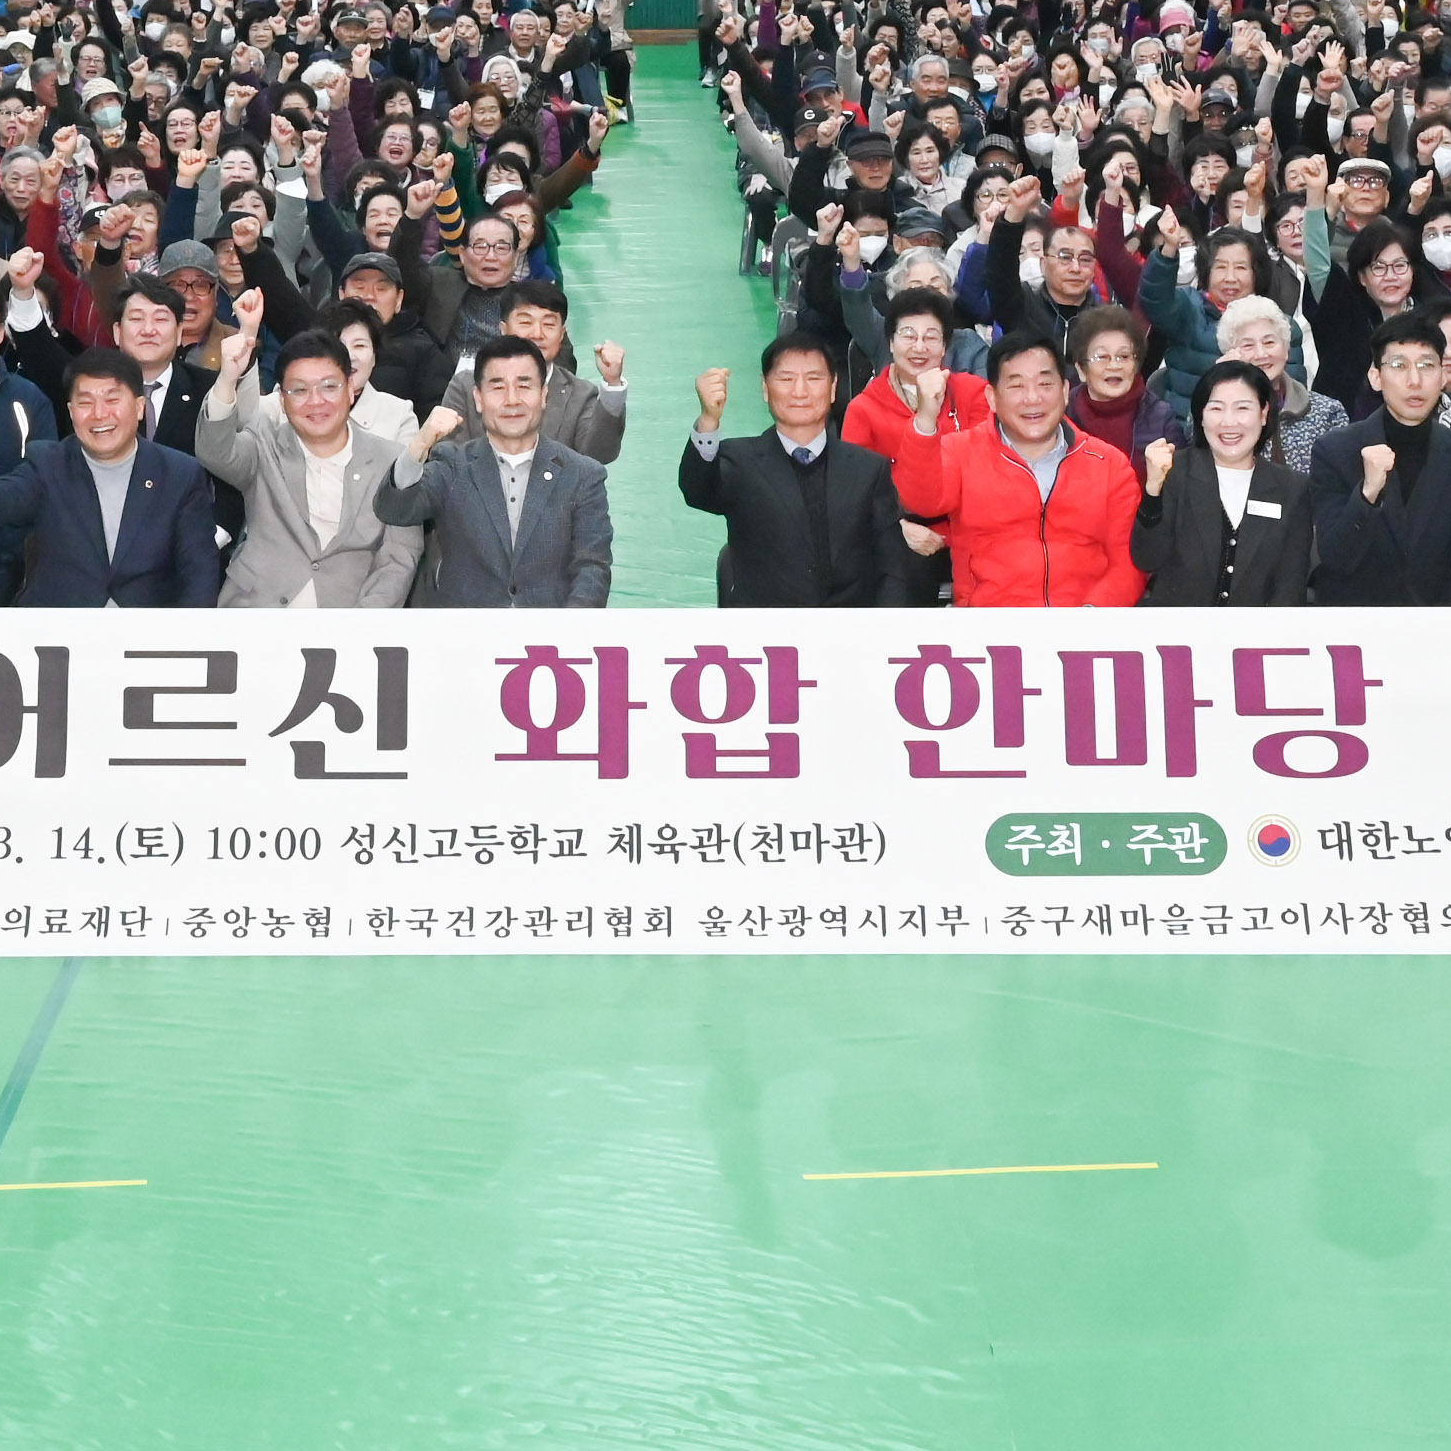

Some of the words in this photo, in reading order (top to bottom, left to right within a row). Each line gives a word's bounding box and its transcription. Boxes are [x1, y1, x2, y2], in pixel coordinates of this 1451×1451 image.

[494, 644, 818, 780] 화합
[888, 643, 1384, 779] 한마당
[209, 825, 321, 862] 10:00
[340, 822, 588, 865] 성신고등학교
[607, 821, 886, 866] 체육관(천마관)
[1004, 822, 1082, 866] 주최
[1126, 822, 1210, 866] 주관
[182, 905, 331, 939] 중앙농협
[366, 905, 672, 939] 한국건강관리협회
[698, 904, 970, 938] 울산광역시지부
